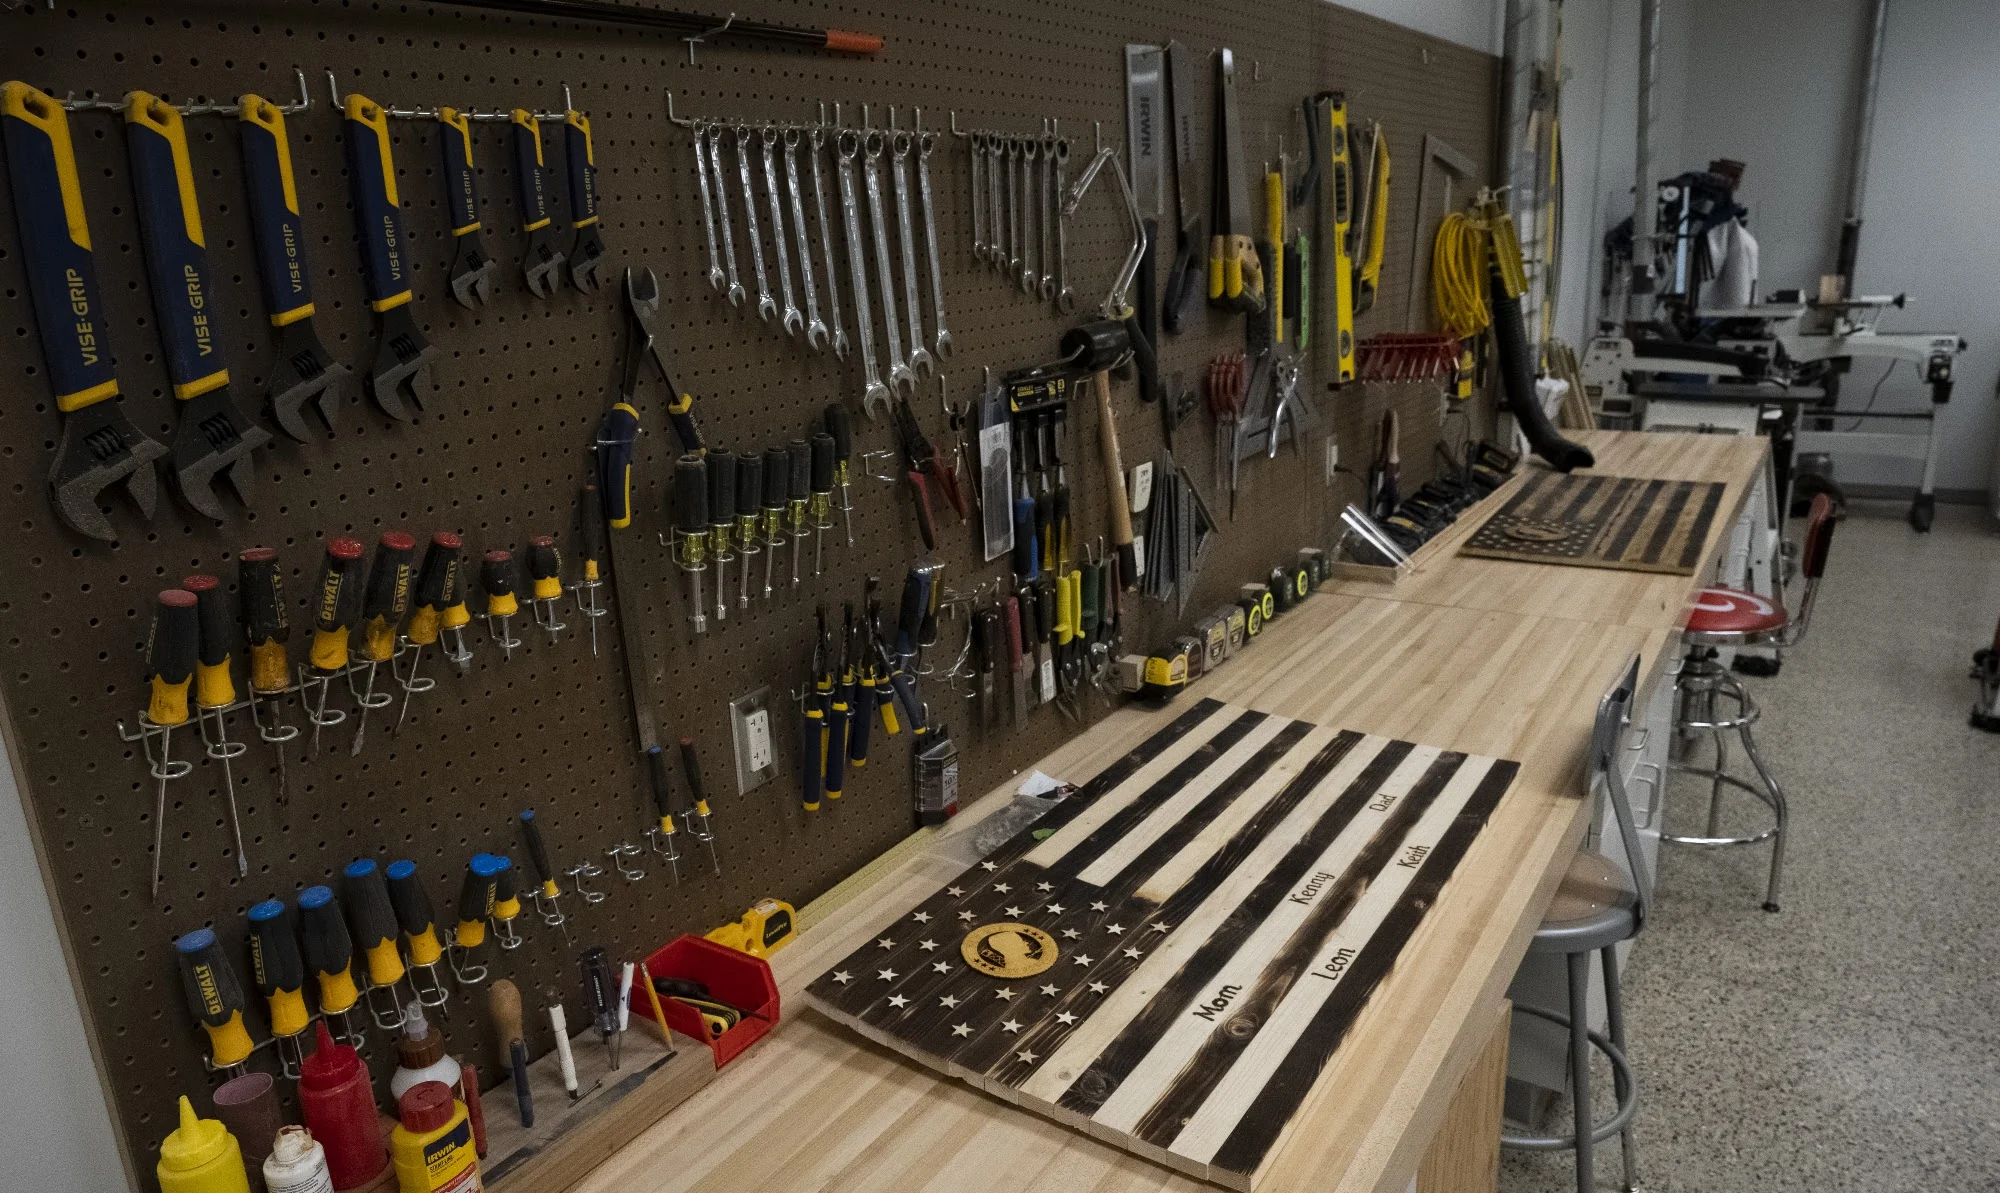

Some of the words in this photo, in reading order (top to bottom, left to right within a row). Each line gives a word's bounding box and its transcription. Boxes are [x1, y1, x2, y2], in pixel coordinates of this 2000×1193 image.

[1140, 97, 1151, 156] IRWIN
[1369, 793, 1397, 812] Dad
[1397, 845, 1431, 868] Keith
[1288, 872, 1335, 905] Kenny
[1311, 947, 1356, 980] Leon
[195, 963, 222, 1015] DEWALT
[1193, 984, 1242, 1021] Mom
[427, 1142, 456, 1163] IRWIN
